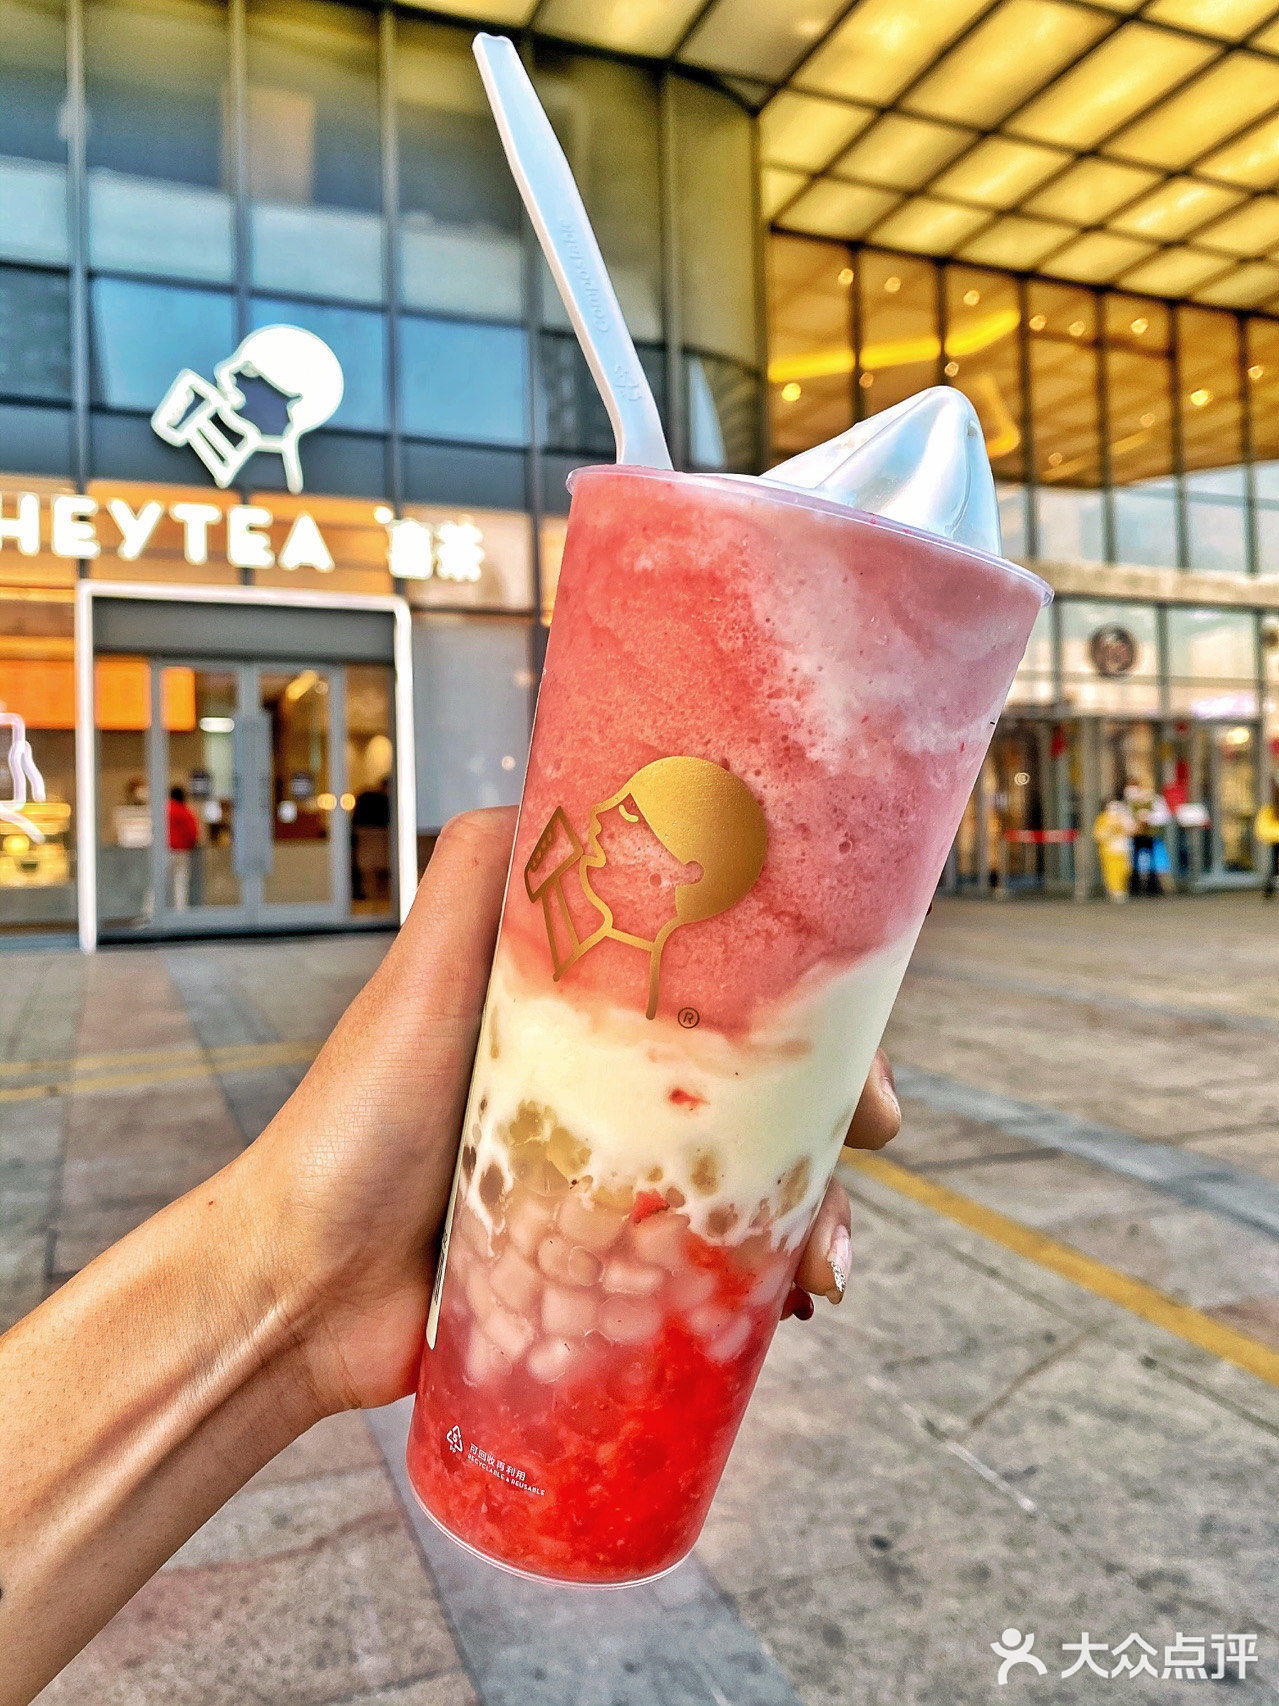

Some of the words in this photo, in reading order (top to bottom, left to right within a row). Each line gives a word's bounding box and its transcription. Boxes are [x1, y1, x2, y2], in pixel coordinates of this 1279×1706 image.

[0, 491, 335, 573] HEYTEA
[470, 1442, 526, 1482] 可回收再利用
[510, 1478, 546, 1496] REUSABLE
